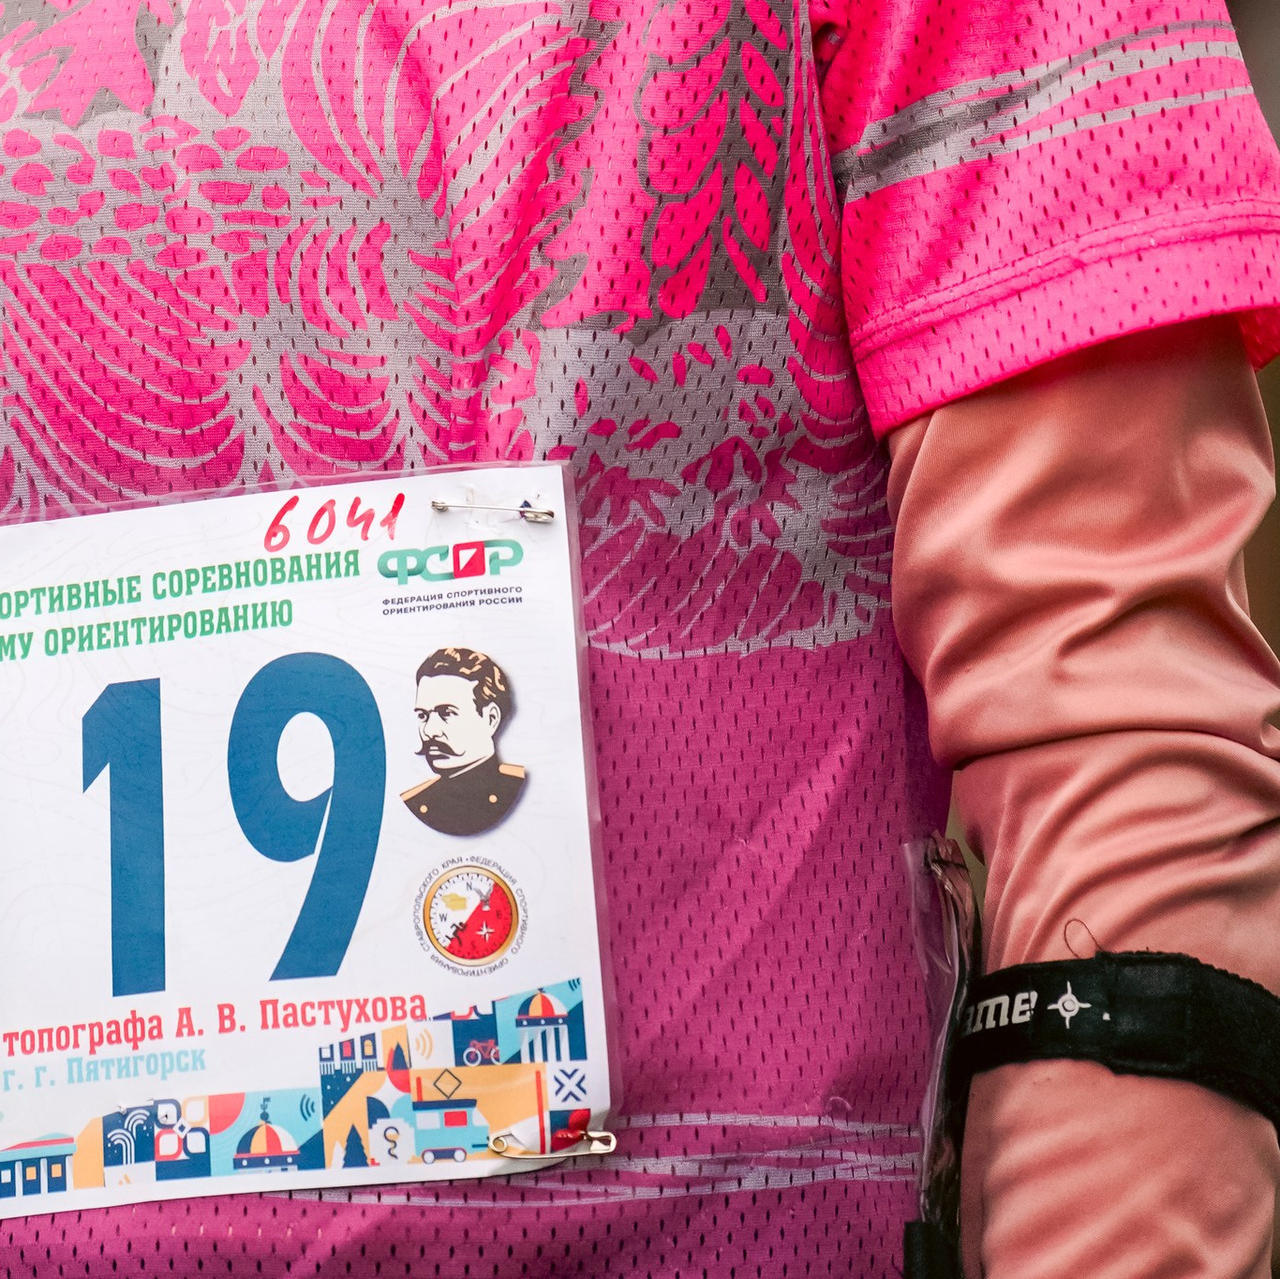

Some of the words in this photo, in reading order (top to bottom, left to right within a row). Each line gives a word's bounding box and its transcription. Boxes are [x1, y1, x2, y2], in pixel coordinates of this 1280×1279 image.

[263, 492, 407, 553] 6041
[152, 549, 361, 601] СОРЕВНОВАНИЯ
[382, 593, 443, 606] ФЕДЕРАЦИЯ
[446, 586, 523, 599] СПОРТИВНОГО
[44, 599, 294, 656] ОРИЕНТИРОВАНИЮ
[382, 600, 476, 615] ОРИЕНТИРОВАНИЯ
[479, 596, 523, 606] РОССИИ
[469, 855, 518, 886] ФЕДЕРАЦИЯ
[2, 1010, 164, 1057] топографа
[175, 1006, 204, 1038] А.
[217, 1002, 246, 1034] В.
[259, 994, 428, 1033] Пастухова
[3, 1068, 24, 1091] г.
[34, 1064, 56, 1088] г.
[67, 1048, 206, 1084] Пятигорск
